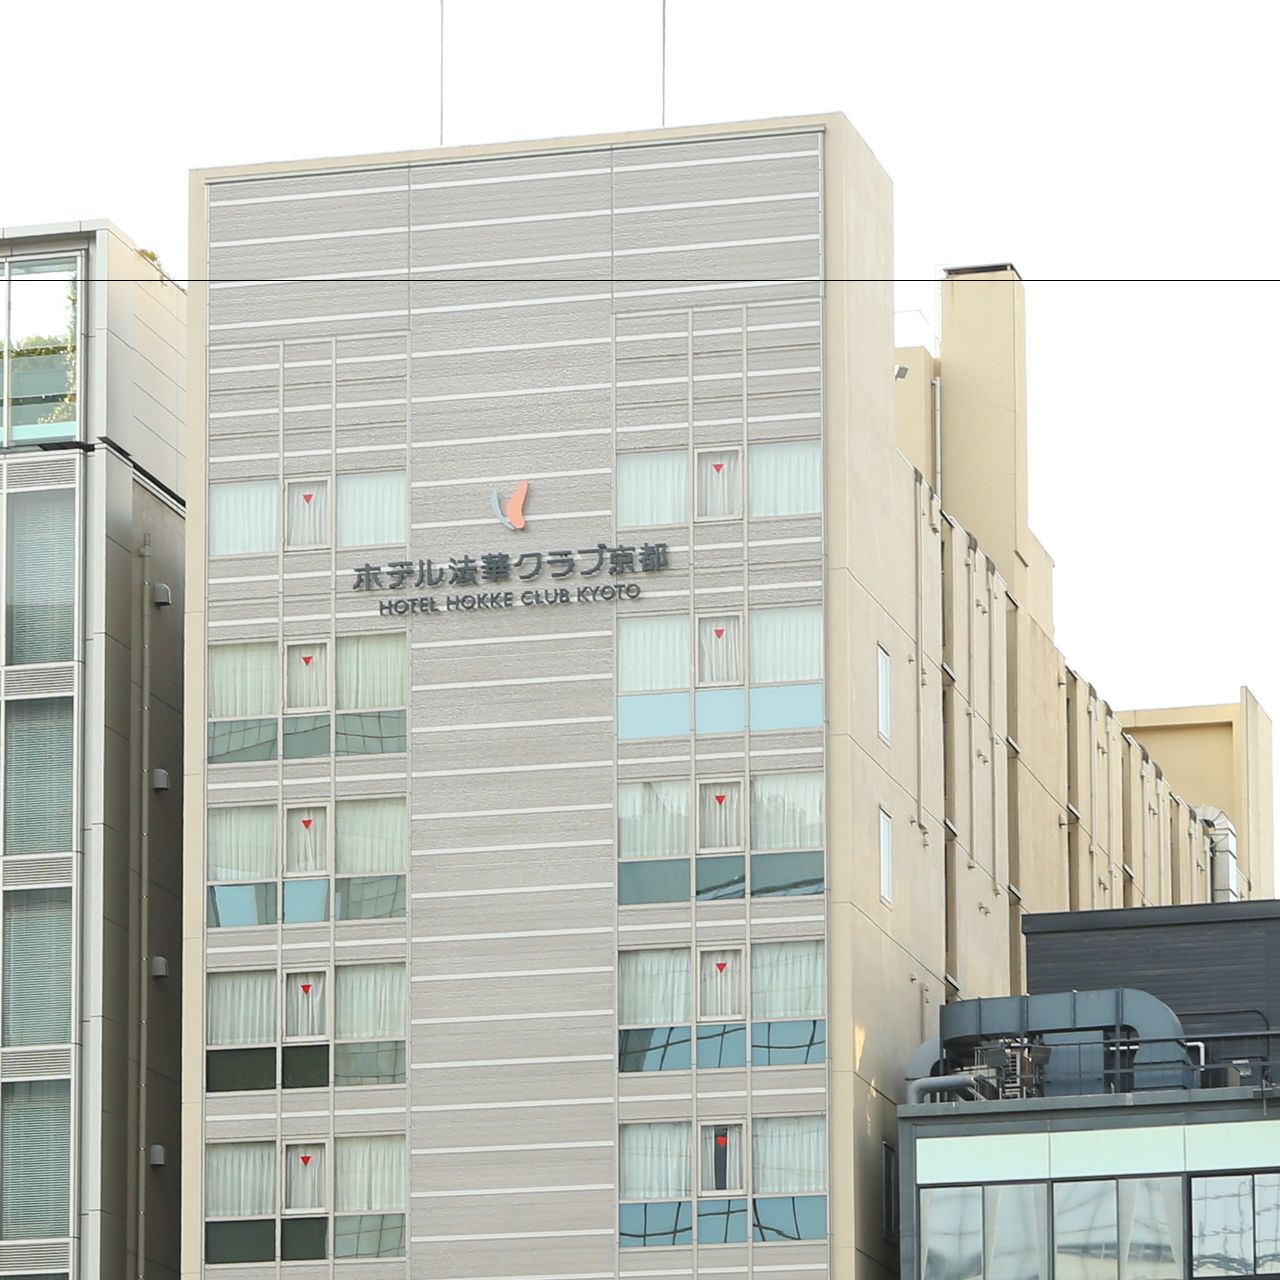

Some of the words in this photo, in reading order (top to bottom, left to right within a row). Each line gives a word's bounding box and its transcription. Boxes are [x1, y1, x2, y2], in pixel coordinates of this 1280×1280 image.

[353, 543, 669, 591] ホテル法華クラブ京都
[379, 597, 440, 616] HOTEL
[446, 592, 512, 611] HOKKE
[521, 589, 570, 606] CLUB
[577, 583, 641, 601] KYOTO
